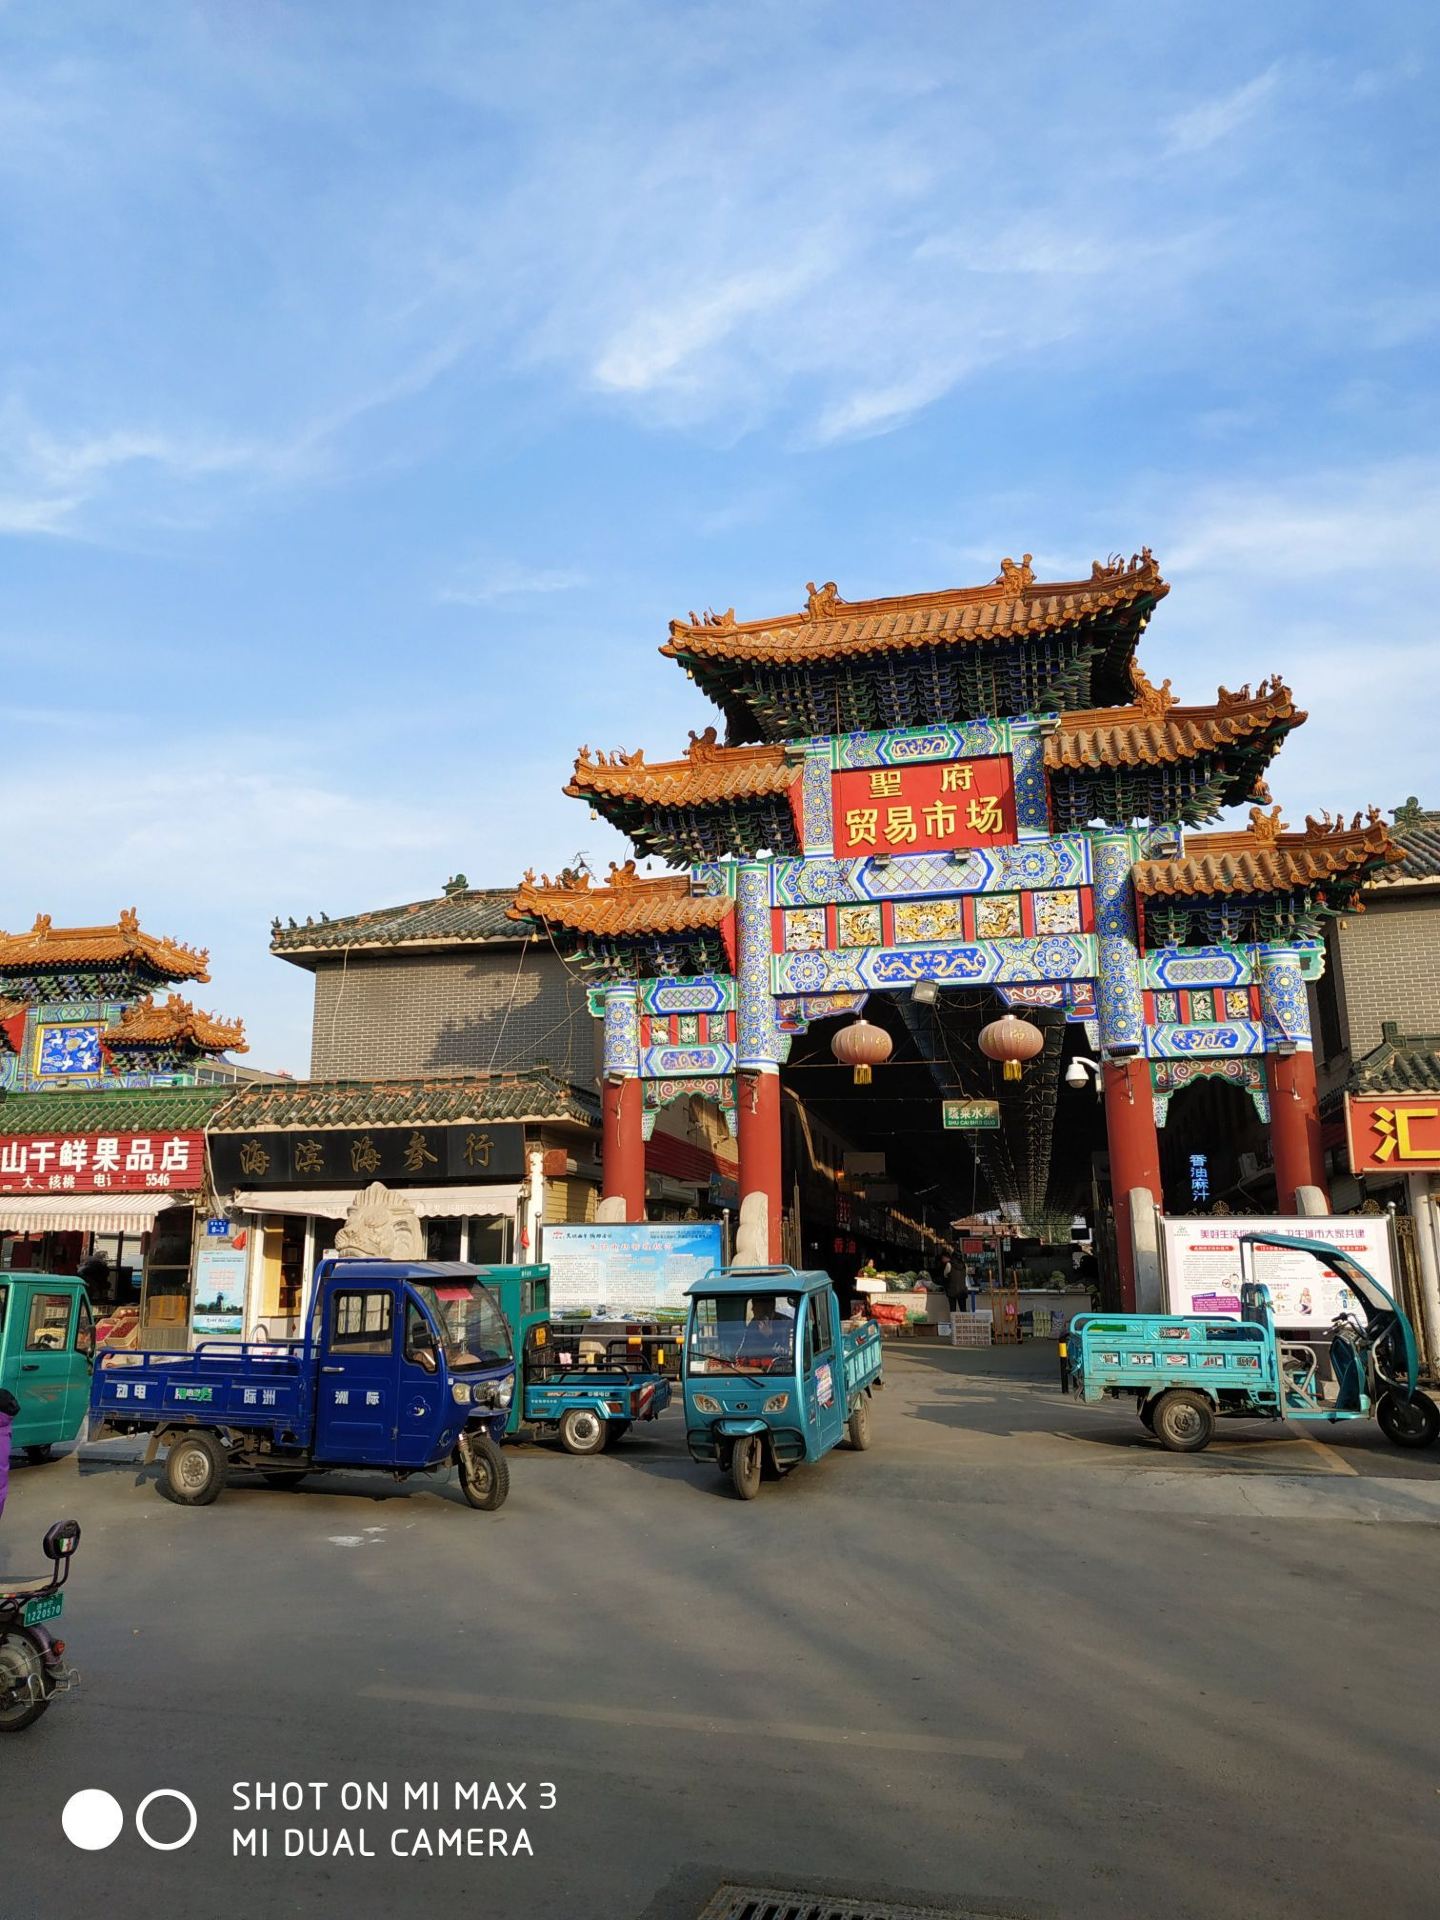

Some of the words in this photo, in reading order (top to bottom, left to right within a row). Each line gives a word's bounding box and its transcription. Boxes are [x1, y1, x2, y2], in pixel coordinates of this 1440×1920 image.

[845, 796, 1003, 847] 贸易市场
[948, 1106, 995, 1120] 蔬菜水果
[1373, 1106, 1440, 1162] 汇
[1, 1136, 190, 1173] 山干鲜果品店
[1189, 1154, 1210, 1202] 香油麻汁
